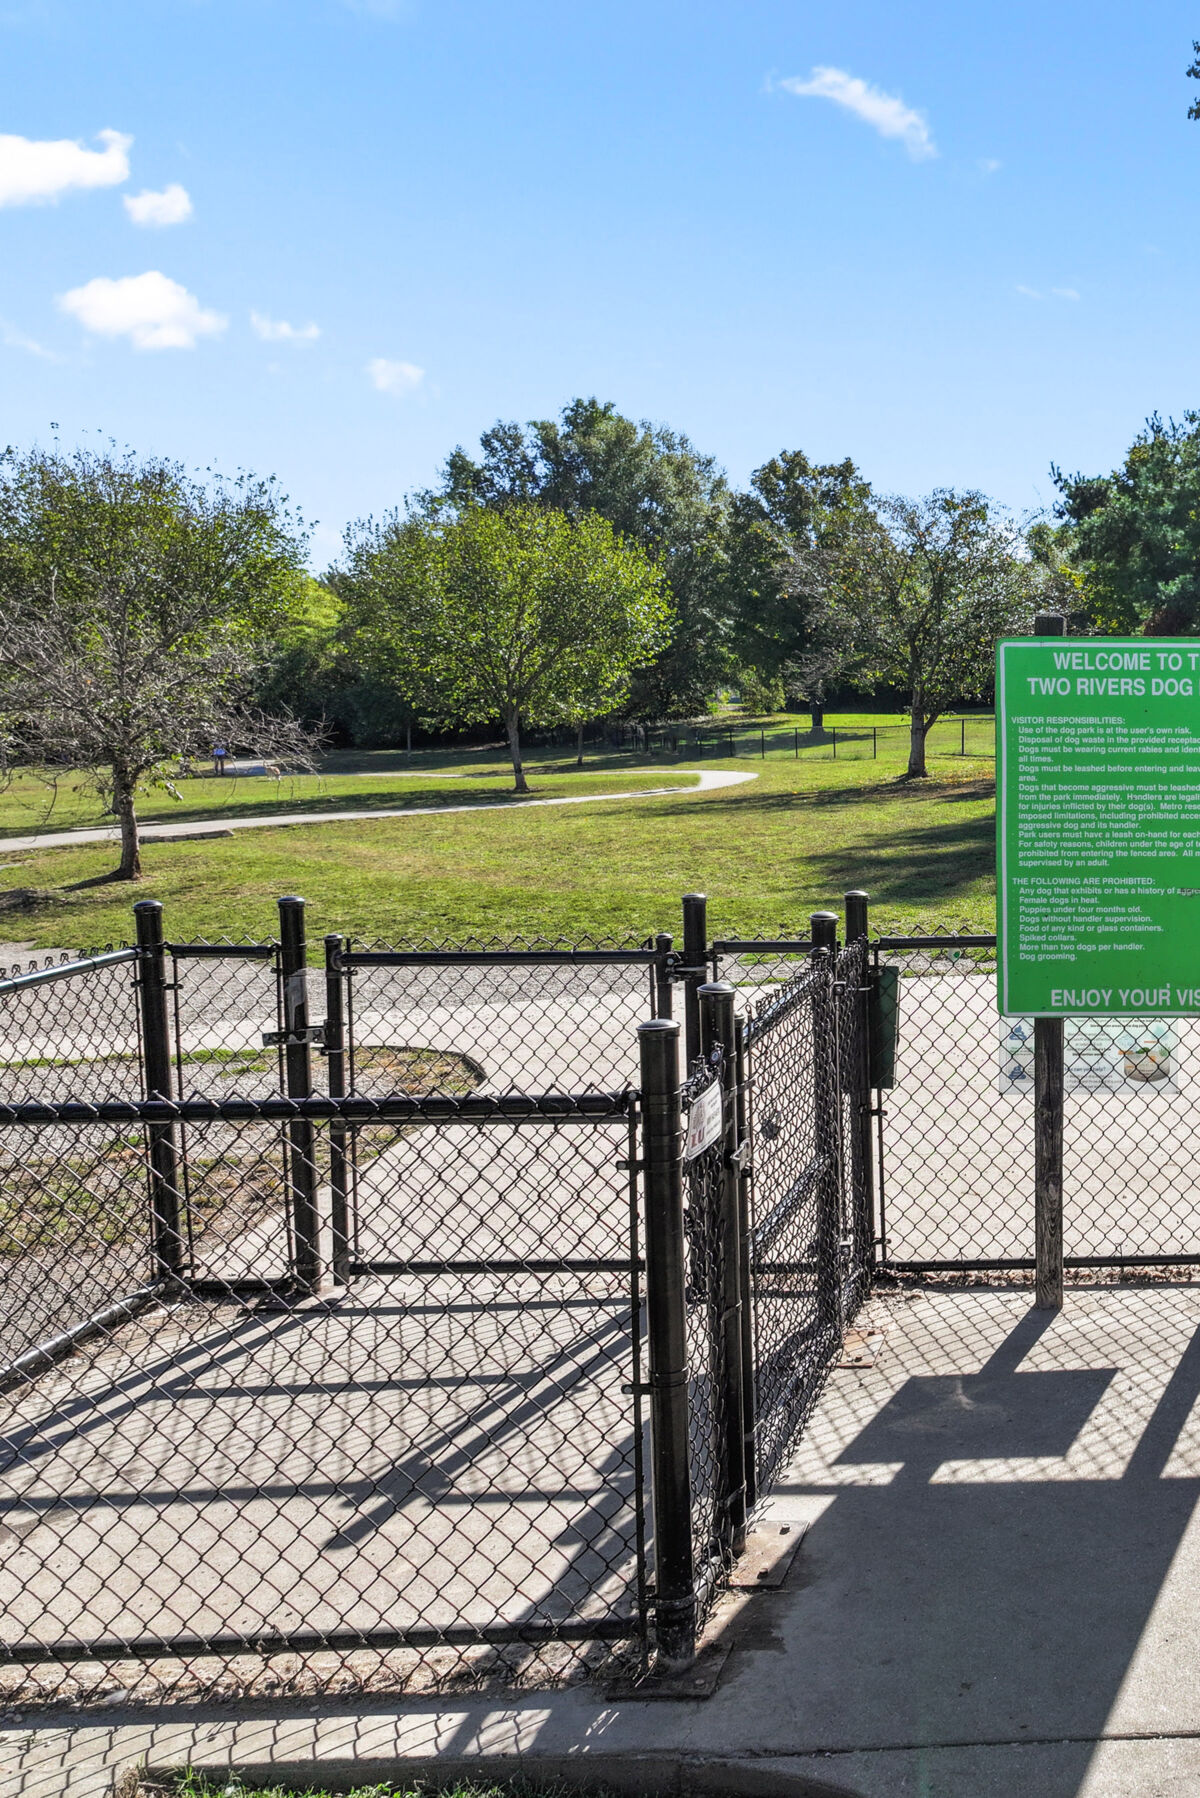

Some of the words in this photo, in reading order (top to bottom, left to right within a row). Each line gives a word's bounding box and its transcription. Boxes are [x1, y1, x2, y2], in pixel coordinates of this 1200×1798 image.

[1053, 652, 1151, 671] WELCOME
[1156, 653, 1182, 671] TO
[1026, 677, 1071, 696] TWO
[1076, 678, 1146, 696] RIVERS
[1151, 678, 1193, 696] DOG
[1046, 716, 1125, 724] RESPONSIBILITIES:
[1060, 726, 1075, 735] dog
[1077, 726, 1094, 735] park
[1018, 736, 1052, 744] Disposal
[1064, 736, 1080, 745] dog
[1131, 736, 1166, 745] provided
[1018, 745, 1039, 754] Dogs
[1074, 745, 1106, 754] wearing
[1108, 745, 1136, 753] current
[1019, 764, 1039, 774] Dogs
[1134, 765, 1167, 774] entering
[1018, 784, 1039, 792] Dogs
[1091, 784, 1134, 793] aggressive
[1053, 793, 1071, 802] park
[1072, 792, 1122, 802] immediately.
[1032, 803, 1061, 812] injuries
[1128, 803, 1156, 812] dog(s).
[1018, 812, 1052, 820] imposed
[1100, 812, 1136, 821] including
[1138, 812, 1178, 821] prohibited
[1018, 822, 1061, 830] aggressive
[1063, 822, 1078, 830] dog
[1018, 850, 1059, 858] prohibited
[1081, 850, 1114, 858] entering
[1019, 859, 1062, 868] supervised
[1019, 887, 1034, 896] Any
[1036, 887, 1052, 896] dog
[1137, 887, 1165, 896] history
[1049, 897, 1069, 905] dogs
[1020, 906, 1051, 914] Puppies
[1020, 915, 1040, 924] Dogs
[1105, 915, 1152, 924] supervision.
[1097, 925, 1118, 933] glass
[1020, 934, 1046, 942] Spiked
[1076, 944, 1096, 952] dogs
[1020, 952, 1035, 961] Dog
[1038, 953, 1077, 961] grooming.
[1051, 989, 1112, 1007] ENJOY
[1118, 988, 1170, 1006] YOUR
